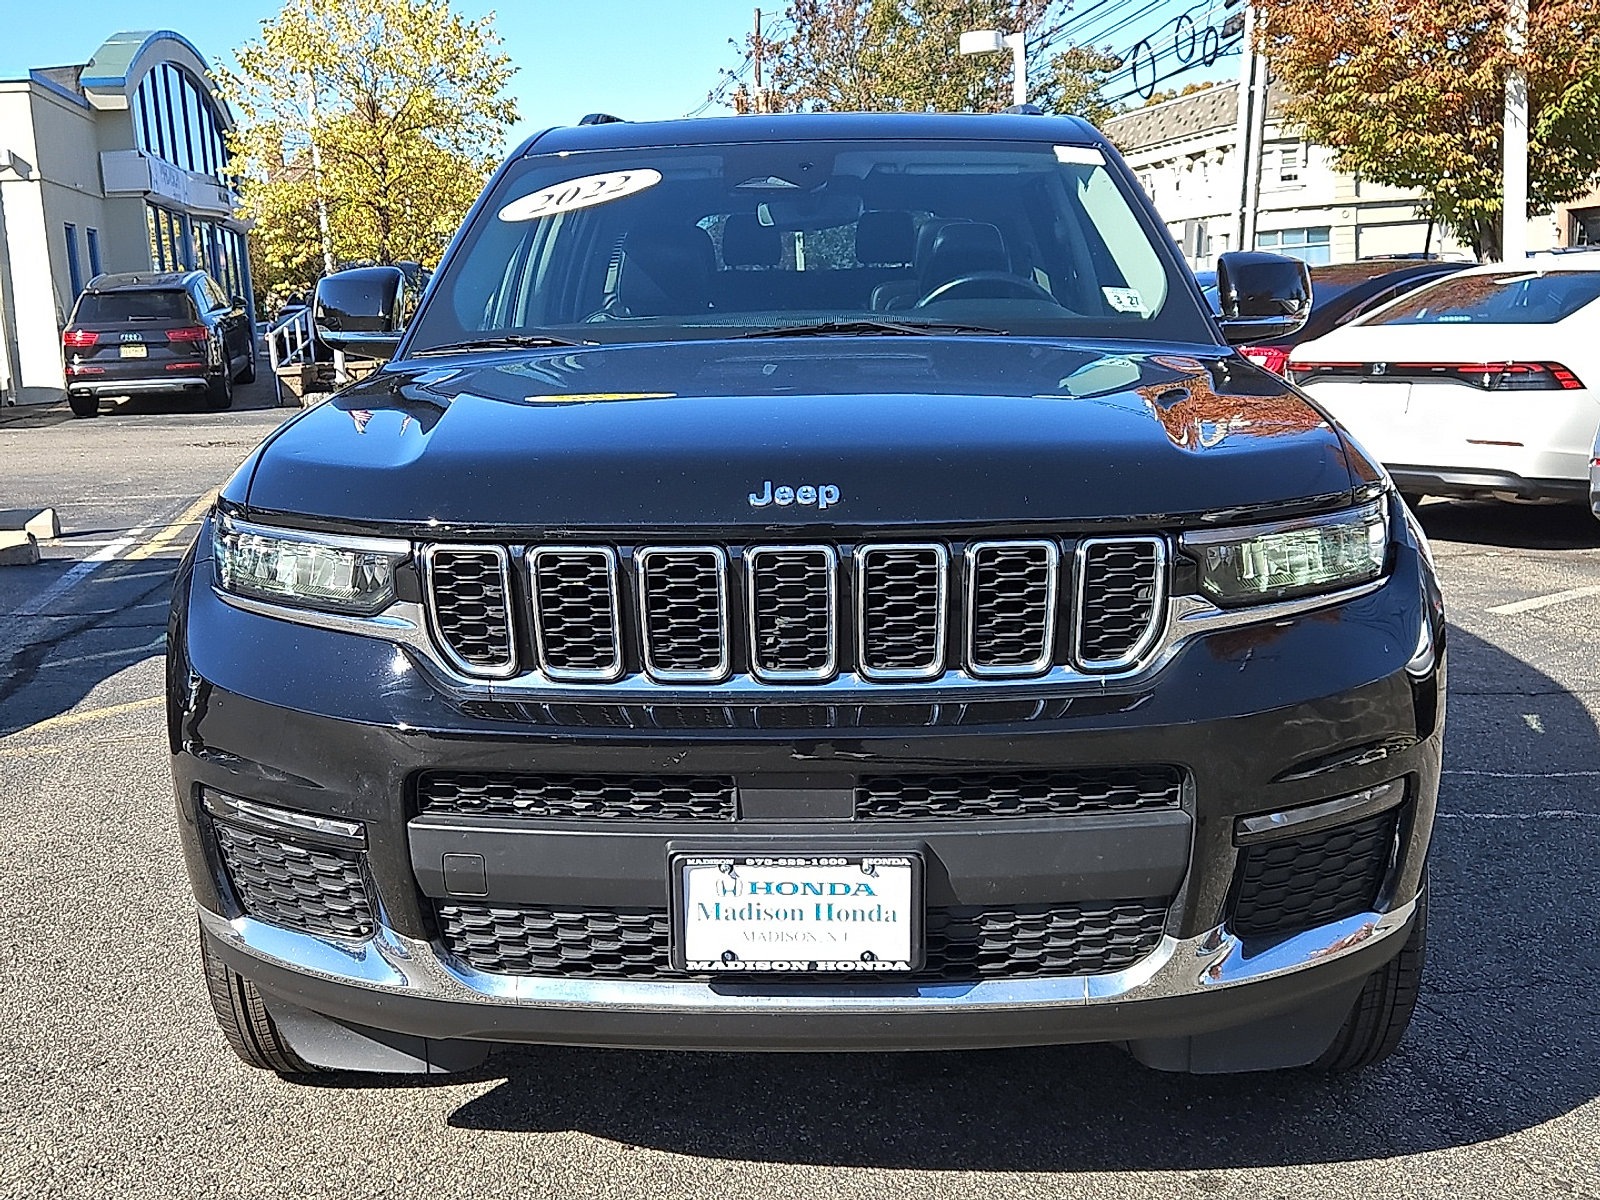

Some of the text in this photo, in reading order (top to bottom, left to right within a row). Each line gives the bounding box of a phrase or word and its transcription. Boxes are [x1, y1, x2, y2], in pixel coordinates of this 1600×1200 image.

[528, 175, 631, 214] 2022
[1126, 294, 1140, 306] 27
[747, 480, 840, 509] Jeep
[686, 858, 735, 866] MADISON
[862, 857, 912, 866] HONDA
[748, 881, 878, 896] HONDA
[697, 902, 897, 923] Madison Honda
[686, 960, 911, 971] MADISON HONDA
